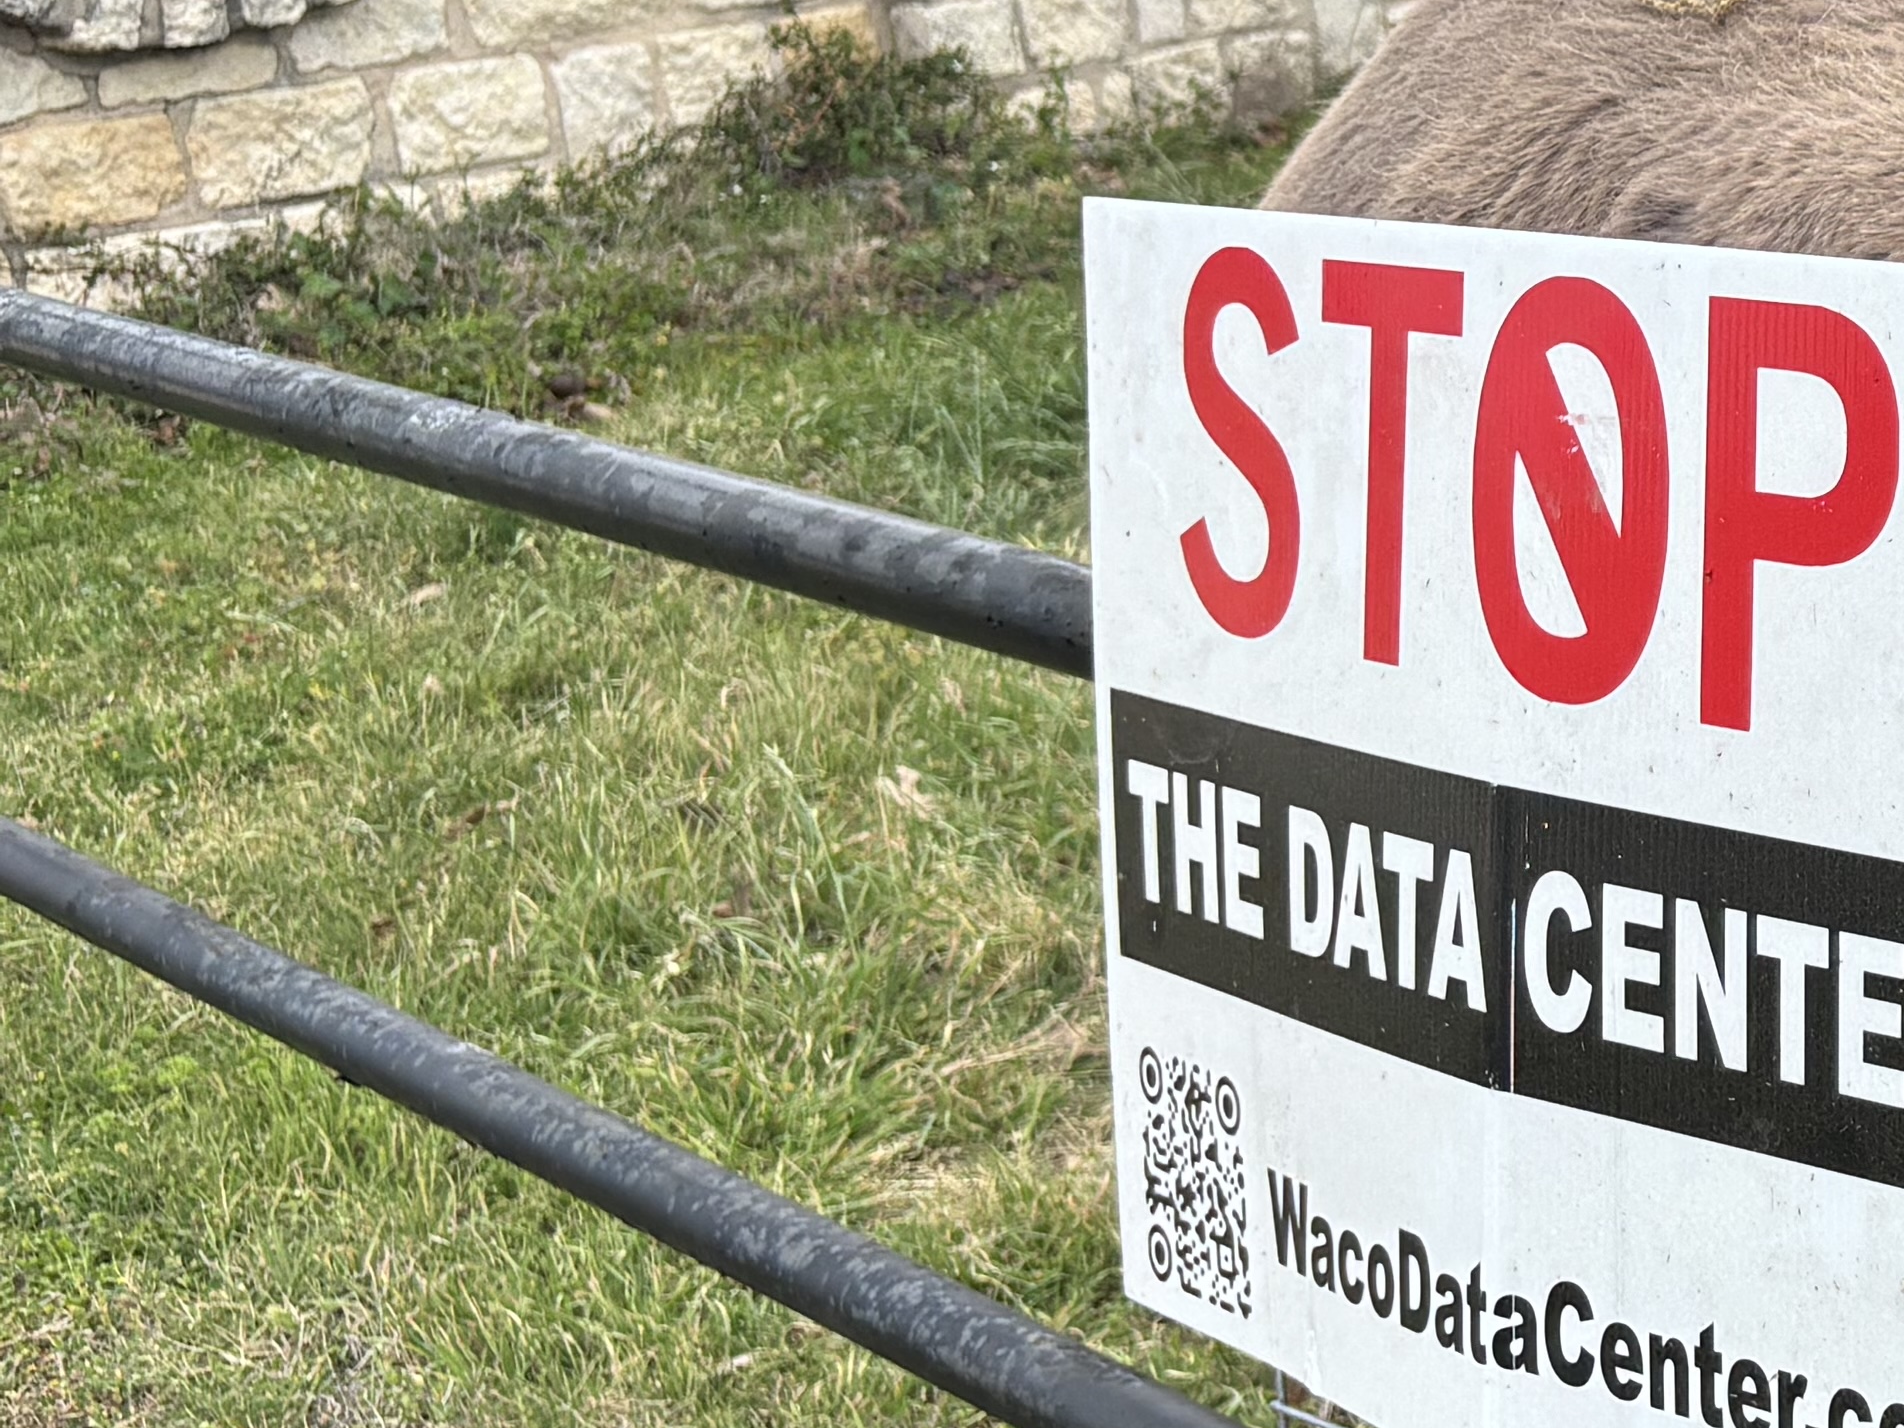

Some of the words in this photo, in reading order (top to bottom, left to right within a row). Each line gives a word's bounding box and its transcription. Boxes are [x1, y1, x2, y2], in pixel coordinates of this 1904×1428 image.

[1180, 247, 1900, 730] STOP
[1127, 759, 1264, 940] THE
[1289, 803, 1490, 1014] DATA
